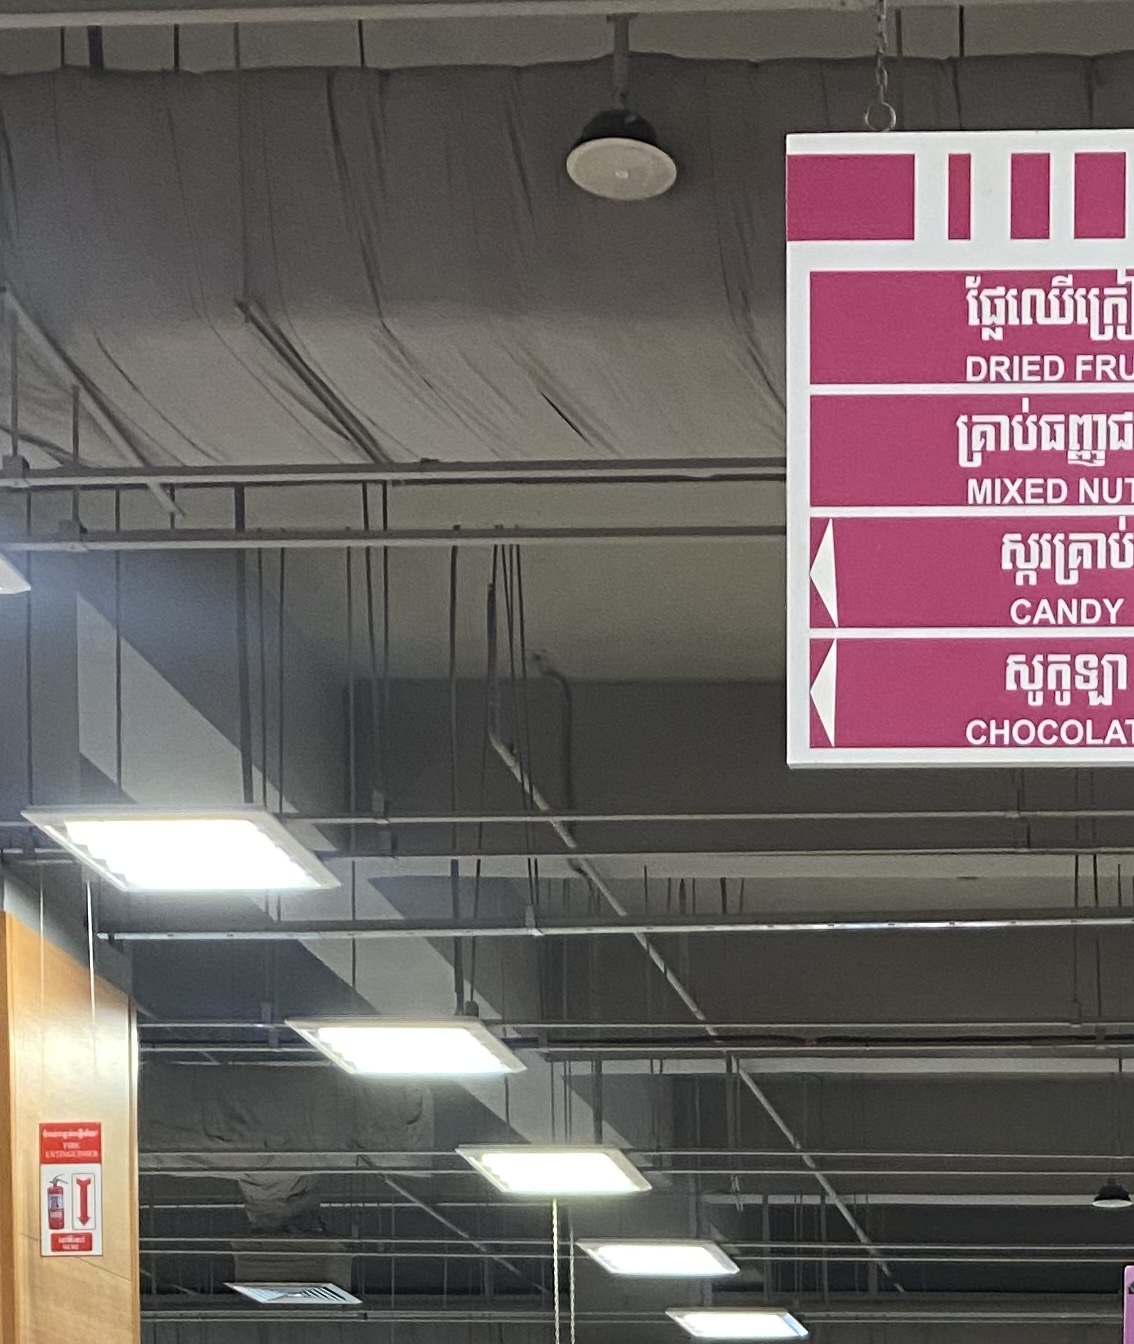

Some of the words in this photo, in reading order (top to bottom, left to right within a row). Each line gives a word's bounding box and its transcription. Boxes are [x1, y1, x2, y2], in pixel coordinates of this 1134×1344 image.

[965, 354, 1065, 382] DRIED
[966, 478, 1069, 504] MIXED
[1009, 598, 1124, 625] CANDY
